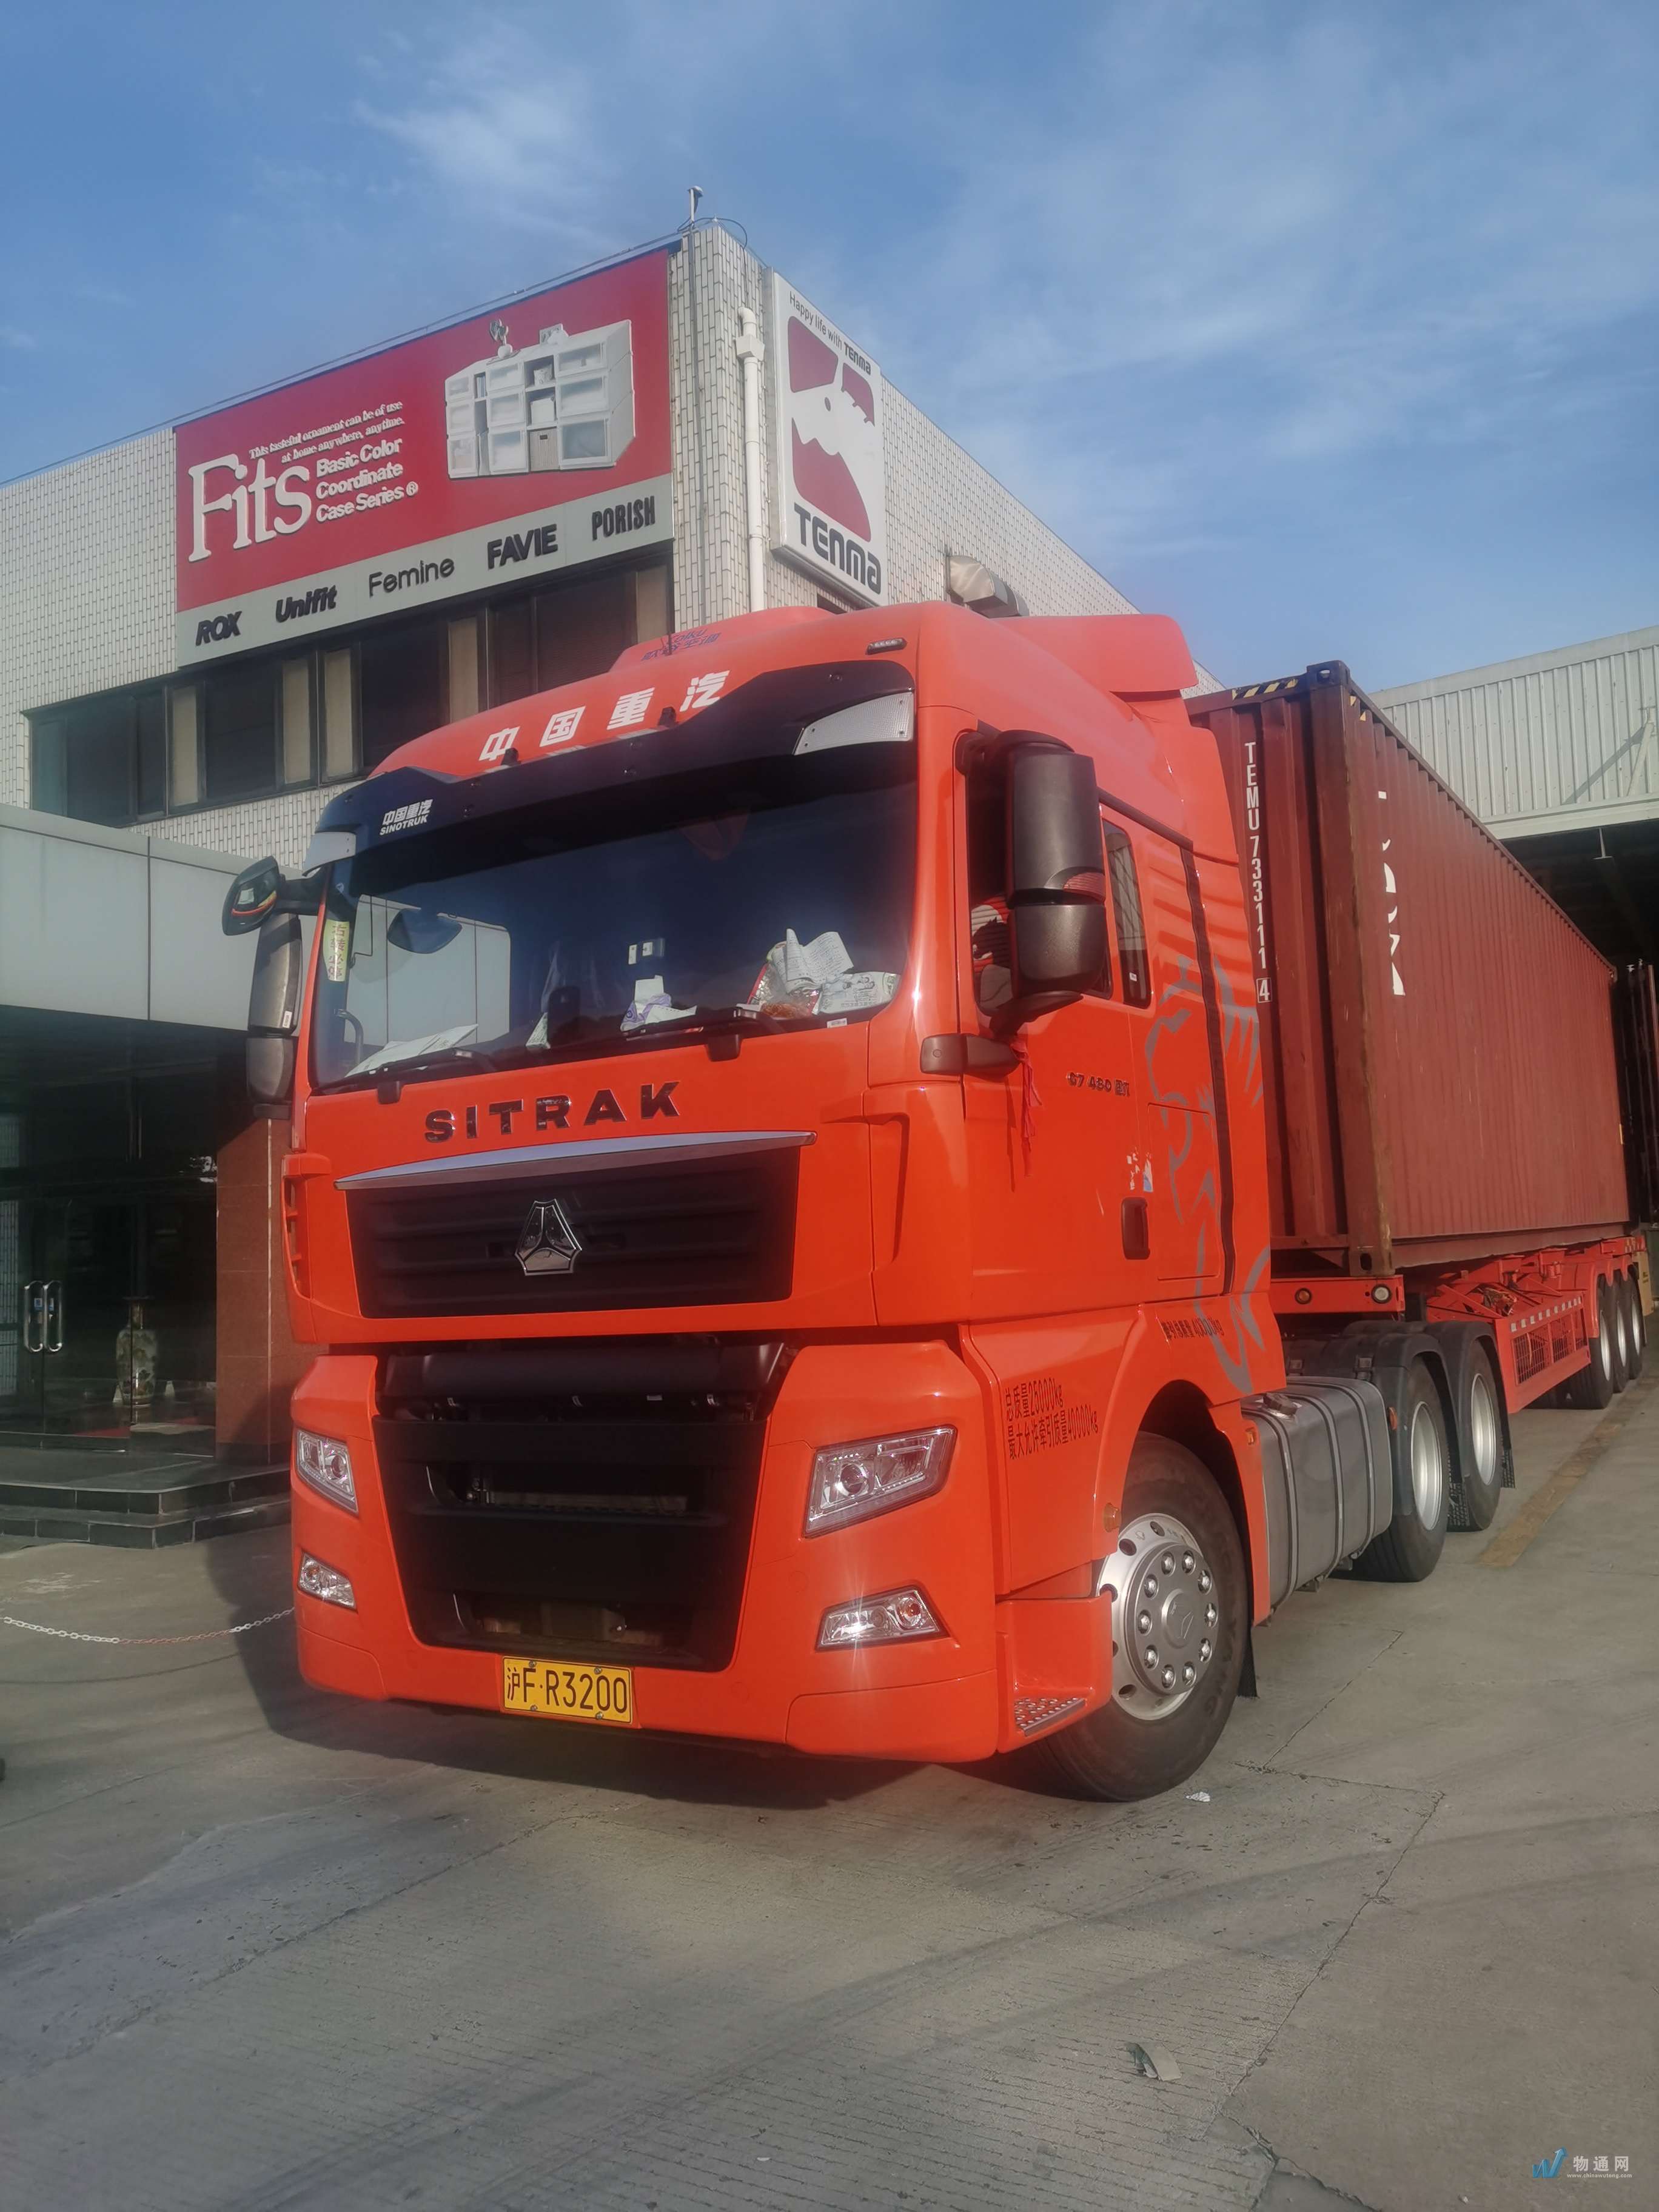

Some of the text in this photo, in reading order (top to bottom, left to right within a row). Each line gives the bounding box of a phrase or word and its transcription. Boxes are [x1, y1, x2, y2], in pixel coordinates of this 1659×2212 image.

[789, 290, 814, 326] Happy
[815, 314, 826, 335] life
[828, 328, 842, 350] with
[249, 401, 403, 459] This tasteful ornament can be of use
[281, 453, 292, 464] at
[293, 445, 317, 460] home
[316, 438, 403, 478] Basic Color
[315, 461, 404, 500] Coordinate
[188, 453, 312, 562] Fits
[315, 501, 355, 523] Case
[355, 486, 404, 512] Series
[592, 495, 655, 541] PORISH
[487, 523, 558, 569] FAVIE
[369, 557, 455, 597] Femine
[275, 585, 338, 623] Unifit
[195, 611, 243, 647] ROX
[478, 669, 730, 762] 中国重汽
[380, 814, 429, 836] SINOTRUK
[382, 799, 434, 826] 中国重汽
[1244, 742, 1270, 1001] TEMU 733111 4
[425, 1081, 680, 1143] SITRAK
[1004, 1376, 1064, 1422] 总质量25000kg
[1008, 1403, 1099, 1460] 最大允许牵引质量40000kg
[507, 1666, 628, 1714] 沪F·R3200
